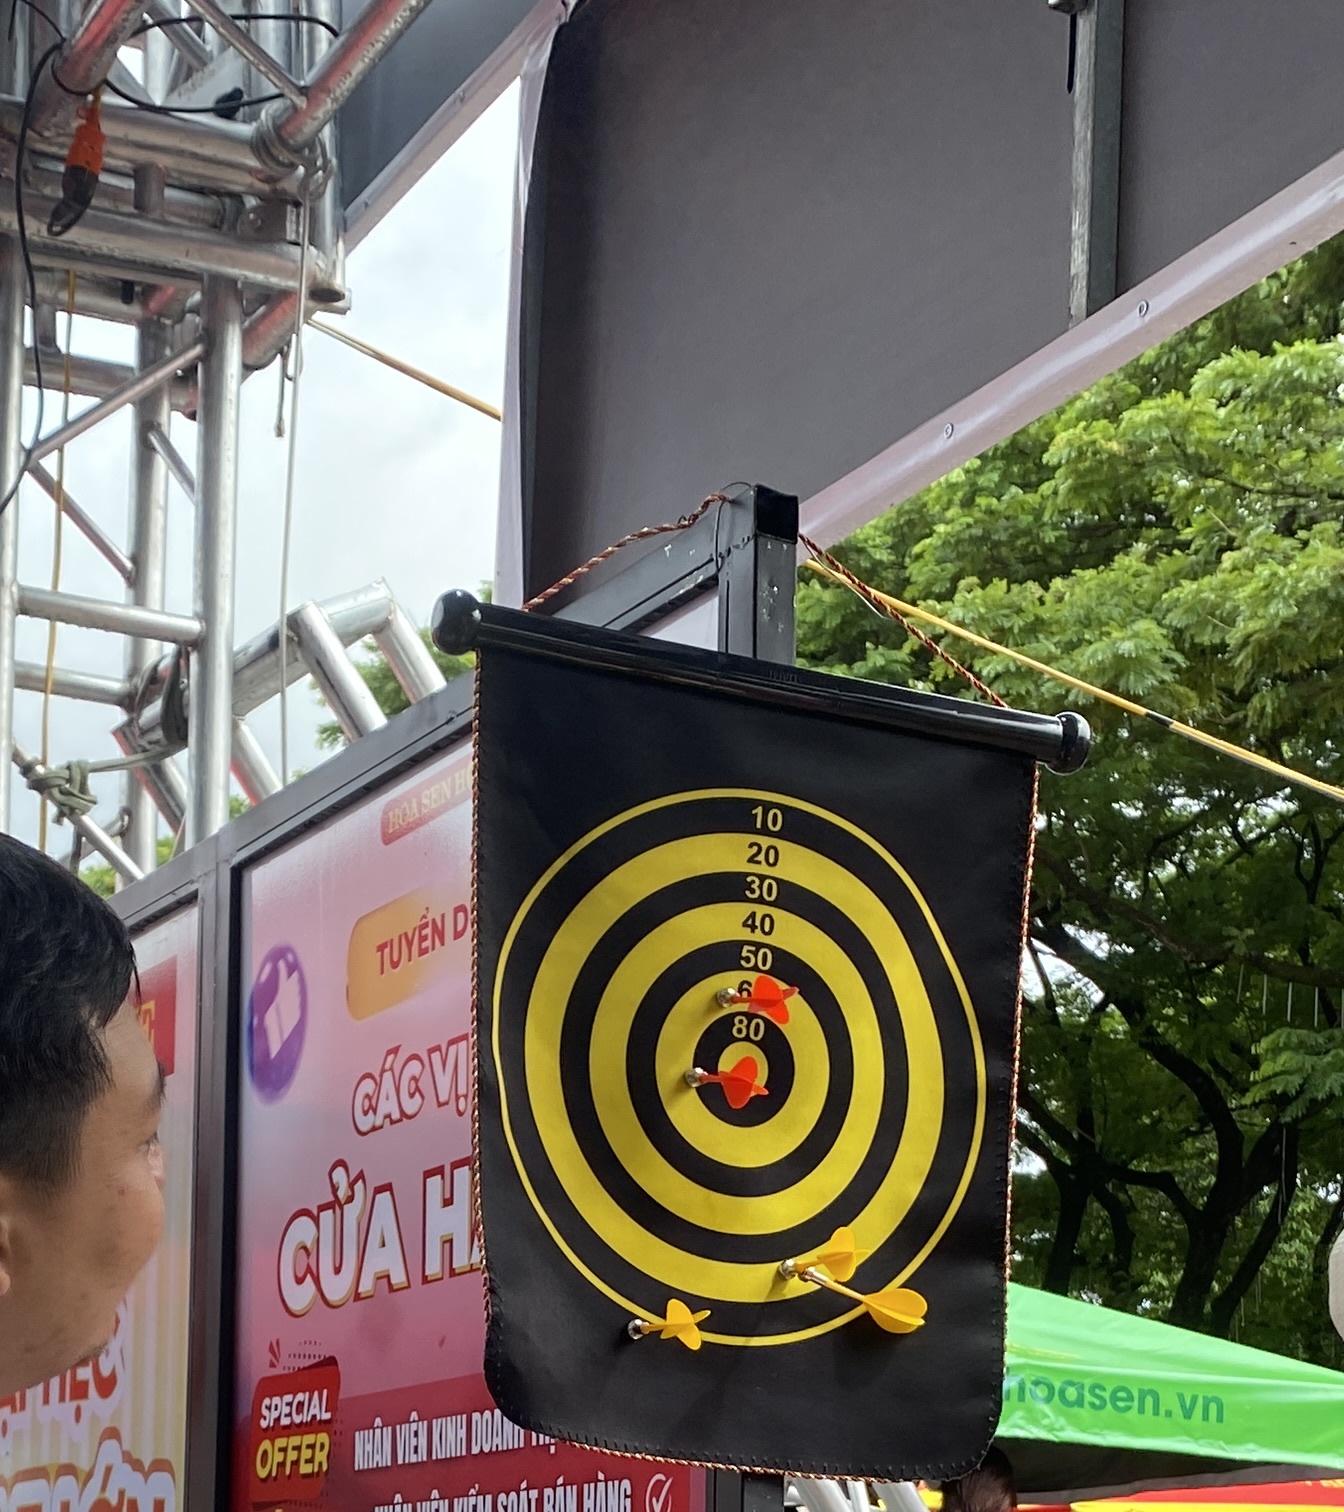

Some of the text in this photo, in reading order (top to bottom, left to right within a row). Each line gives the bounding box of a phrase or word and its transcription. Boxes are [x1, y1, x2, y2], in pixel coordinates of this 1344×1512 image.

[421, 777, 452, 813] SEN
[751, 806, 783, 832] 10
[746, 842, 779, 867] 20
[745, 875, 778, 901] 30
[376, 907, 445, 976] TUYỂN
[742, 911, 775, 936] 40
[740, 945, 772, 971] 50
[732, 1015, 765, 1041] 80
[353, 1033, 470, 1137] CÁC VỊ
[277, 1158, 411, 1318] CỬA
[259, 1389, 331, 1429] SPECIAL
[256, 1432, 331, 1479] OFFER
[354, 1417, 392, 1471] NHÂN
[396, 1411, 428, 1465] VIÊN
[431, 1414, 467, 1460] KINH
